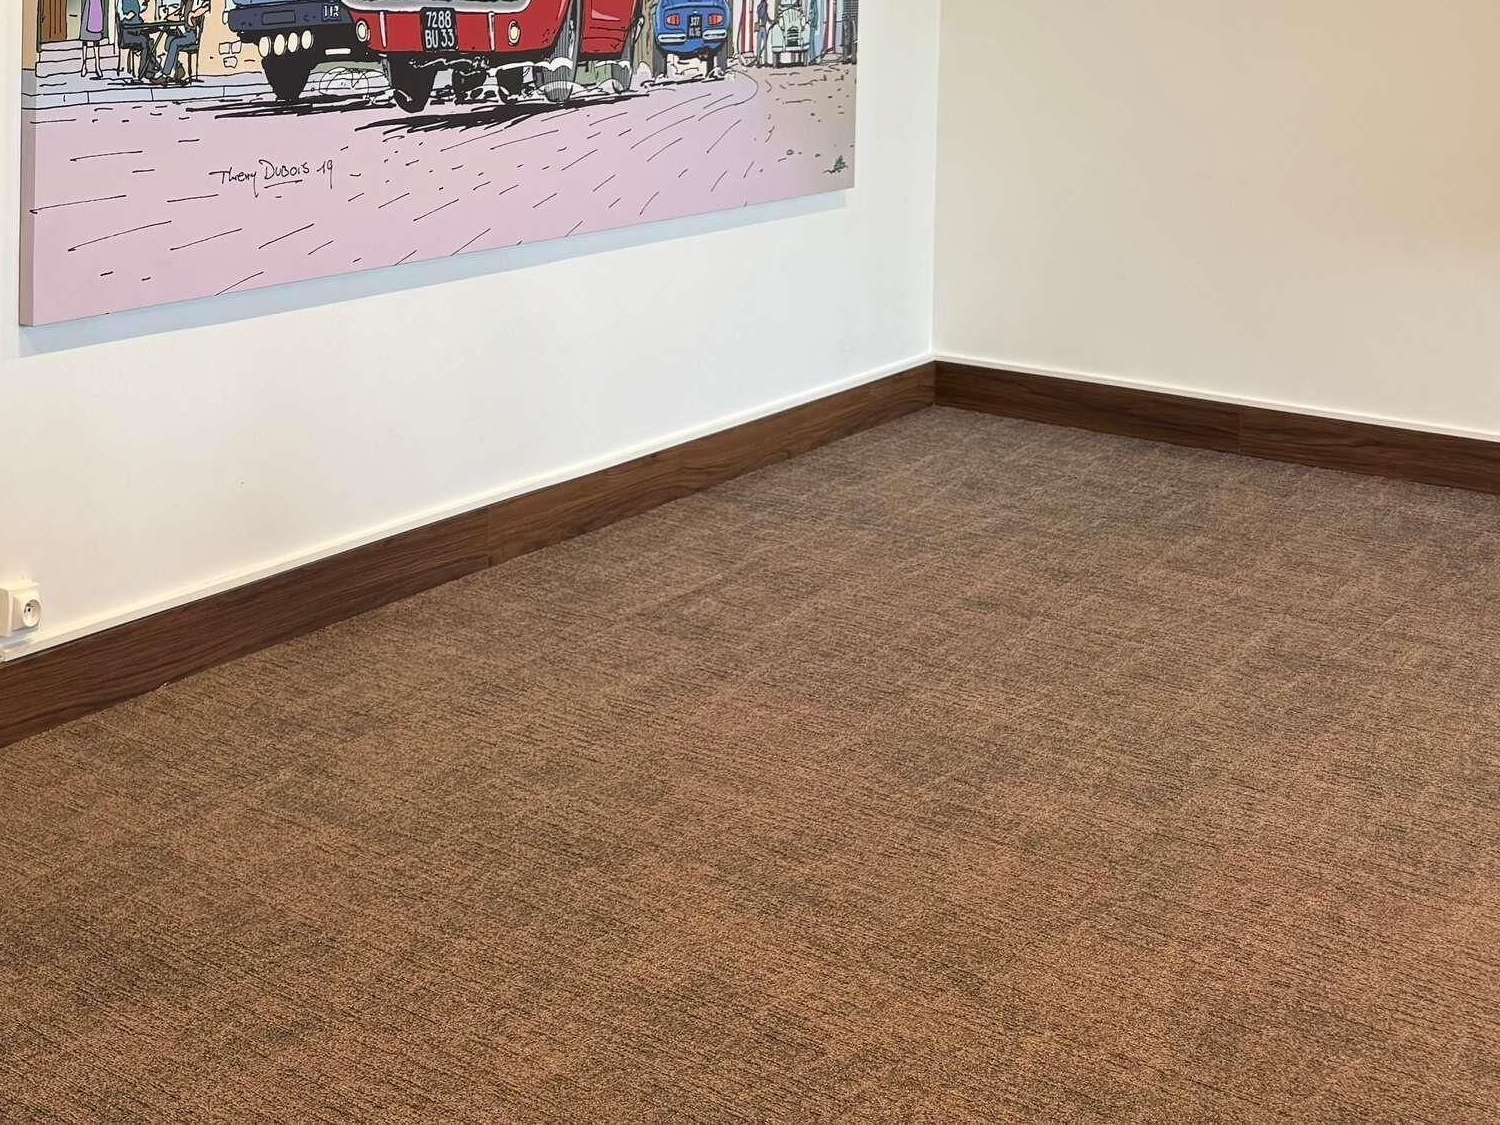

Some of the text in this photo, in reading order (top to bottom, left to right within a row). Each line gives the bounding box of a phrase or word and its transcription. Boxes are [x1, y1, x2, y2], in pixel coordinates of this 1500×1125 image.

[426, 11, 452, 29] 7288
[424, 29, 455, 49] BU 33
